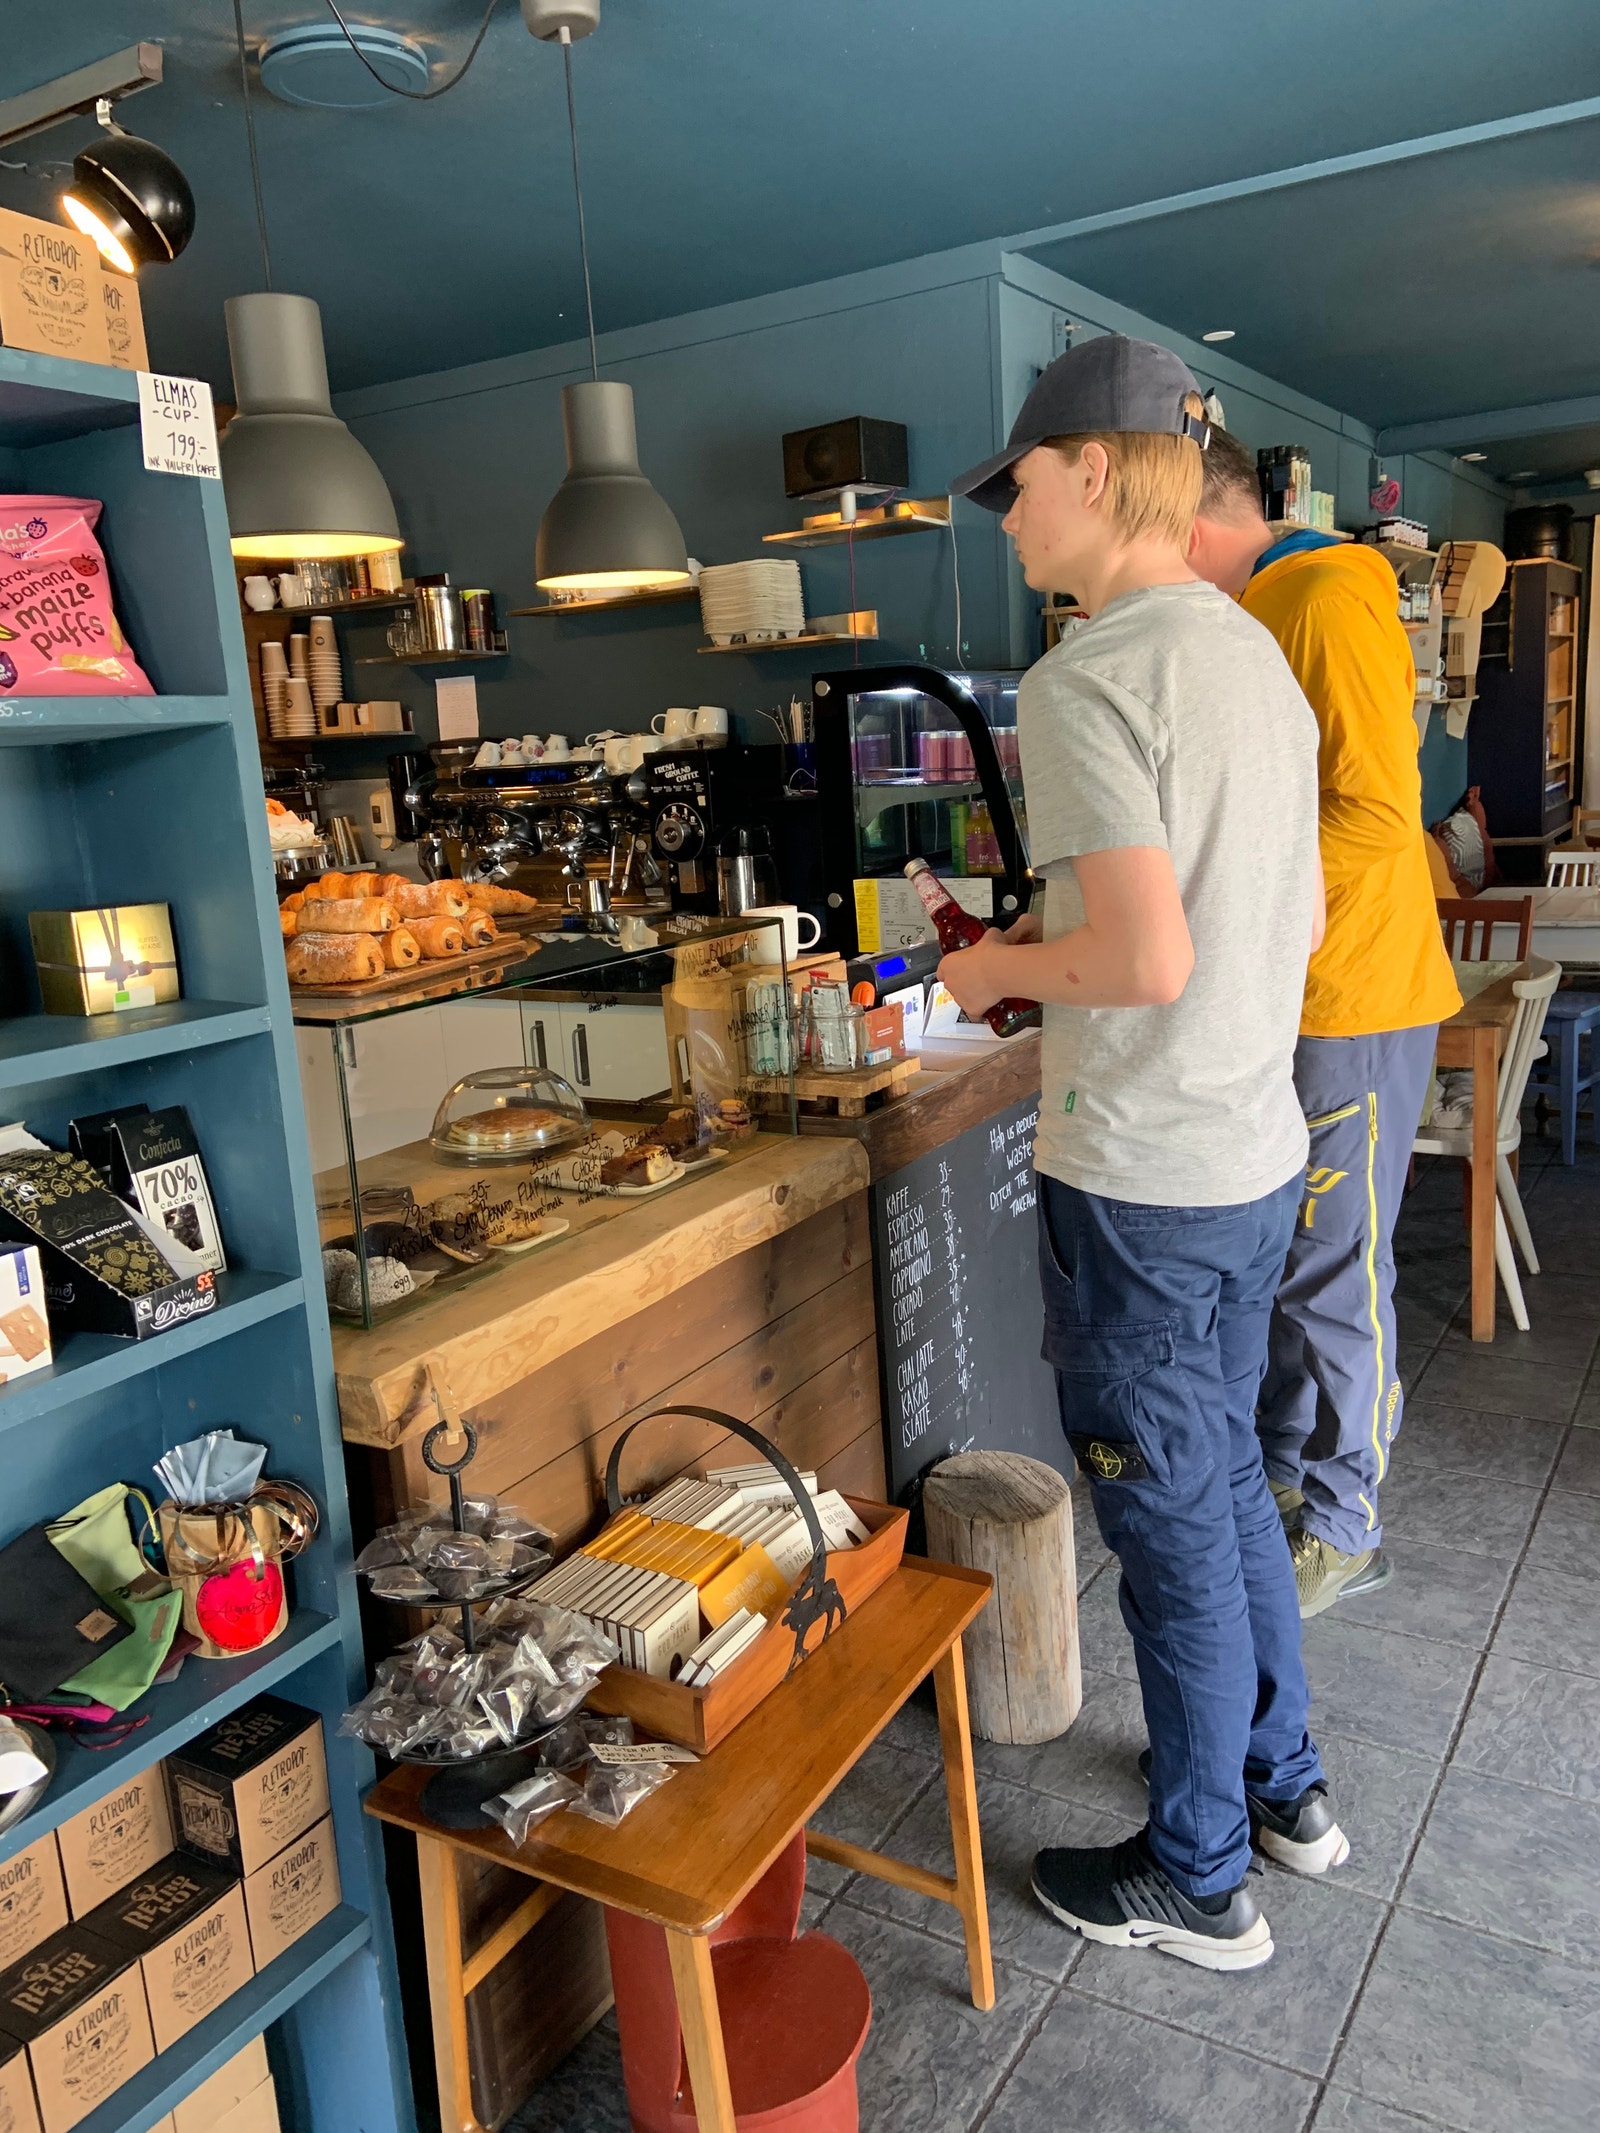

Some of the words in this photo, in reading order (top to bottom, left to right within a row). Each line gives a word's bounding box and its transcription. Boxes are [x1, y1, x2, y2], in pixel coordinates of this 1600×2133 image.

[24, 233, 80, 272] RETROPOT
[153, 378, 197, 408] ELMAS
[15, 582, 94, 629] maize
[30, 611, 105, 661] puffs
[654, 763, 675, 775] FRESH
[664, 766, 691, 778] GROUND
[676, 771, 699, 783] COFFEE
[140, 1136, 182, 1162] Confecta
[990, 1124, 1005, 1153] Help
[144, 1162, 197, 1204] 70%
[160, 1195, 193, 1209] cacao
[886, 1186, 910, 1218] KAFFE
[990, 1181, 1012, 1210] DITCH
[1014, 1169, 1029, 1189] THE
[61, 1242, 76, 1251] 70%
[76, 1233, 95, 1245] DARK
[96, 1220, 133, 1237] CHOCOLATE
[888, 1204, 924, 1245] ESPRESSO
[893, 1286, 923, 1326] CORTADO
[896, 1317, 916, 1347] LATTE
[897, 1356, 915, 1392] CHAI
[915, 1339, 935, 1376] LATTE
[901, 1376, 929, 1419] KAKAO
[212, 1713, 268, 1759] RETRO
[245, 1713, 284, 1745] POT
[262, 1746, 307, 1793] RETROPOT
[90, 1786, 143, 1836] RETROPOT
[272, 1841, 318, 1889] RETROPOT
[123, 1875, 186, 1930] RETRO
[159, 1877, 200, 1913] POT
[175, 1913, 225, 1967] RETROPOT
[11, 1952, 81, 2014] RETRO
[50, 1954, 97, 1995] POT
[65, 1993, 123, 2051] RETROPOT
